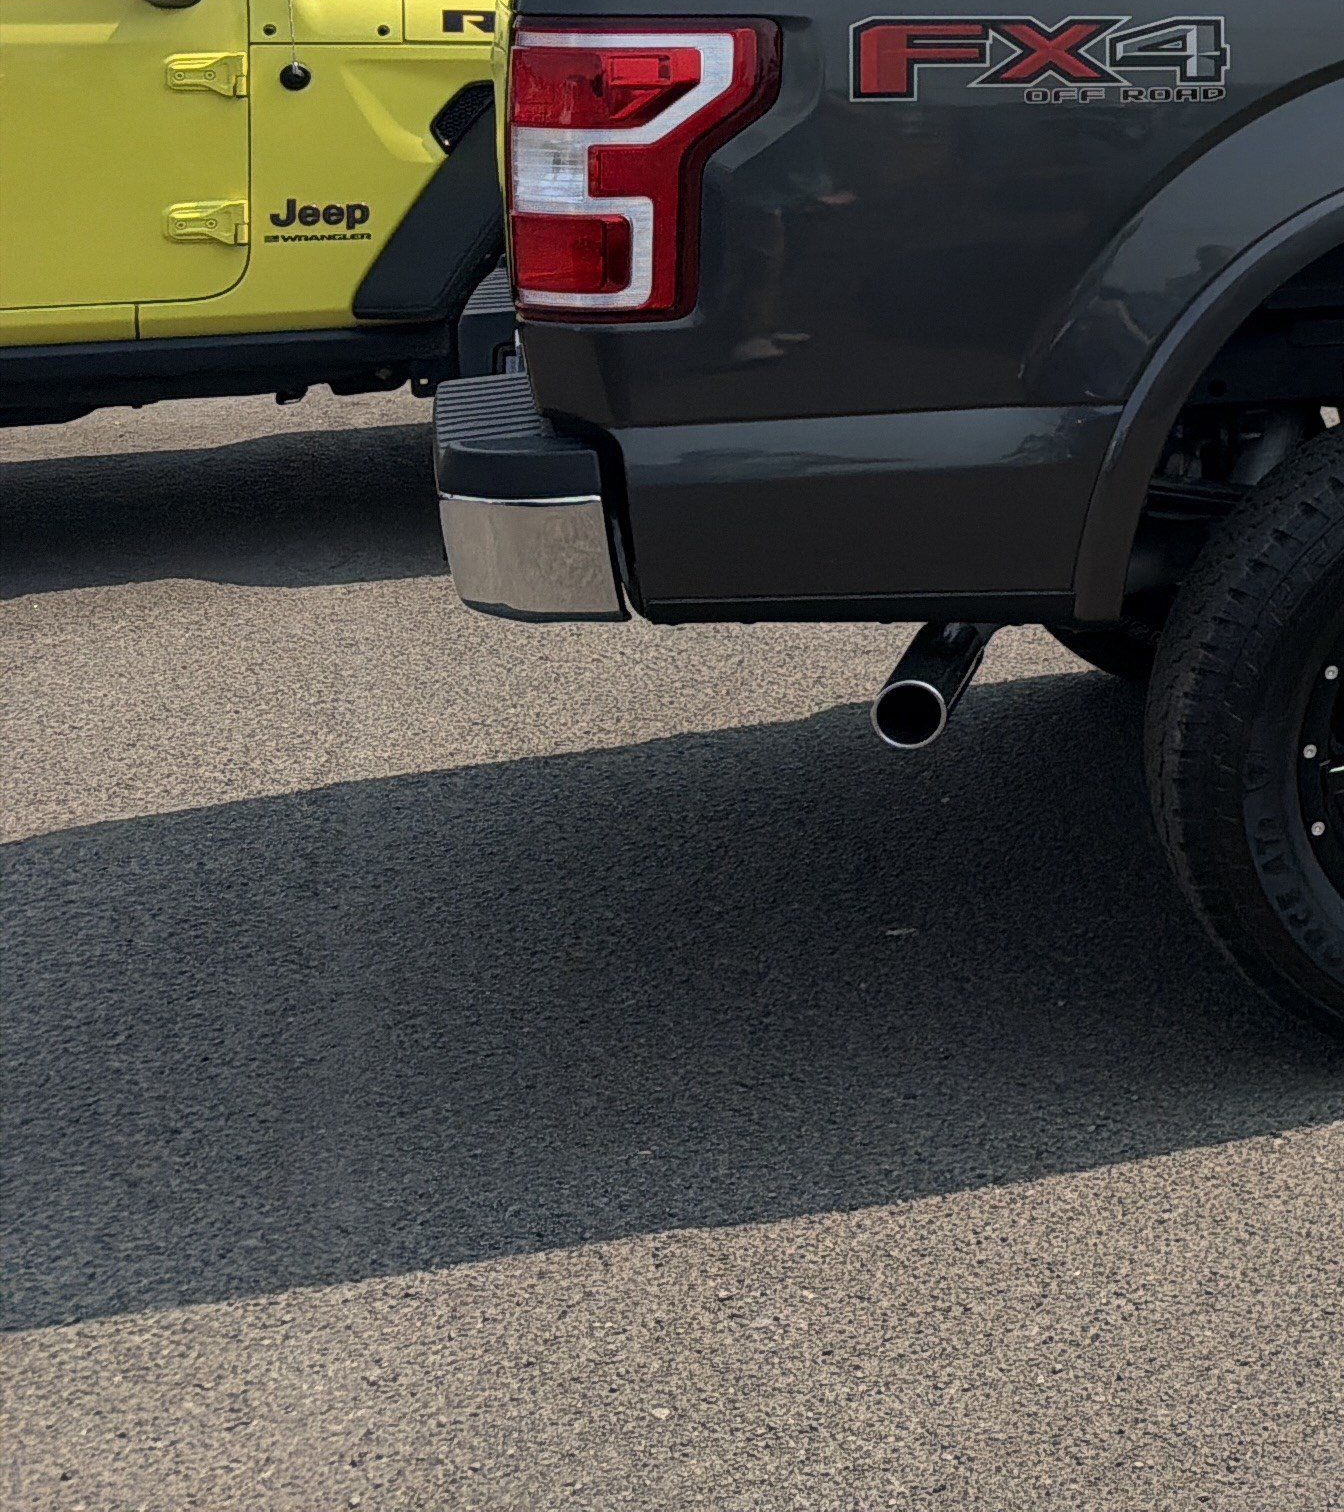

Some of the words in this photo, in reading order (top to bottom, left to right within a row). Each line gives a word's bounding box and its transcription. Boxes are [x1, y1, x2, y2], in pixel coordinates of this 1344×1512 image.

[849, 16, 1230, 102] FX4
[1023, 87, 1106, 105] OFF
[1119, 87, 1228, 104] ROAD
[269, 198, 371, 230] Jeep
[280, 232, 372, 243] WRANGLER
